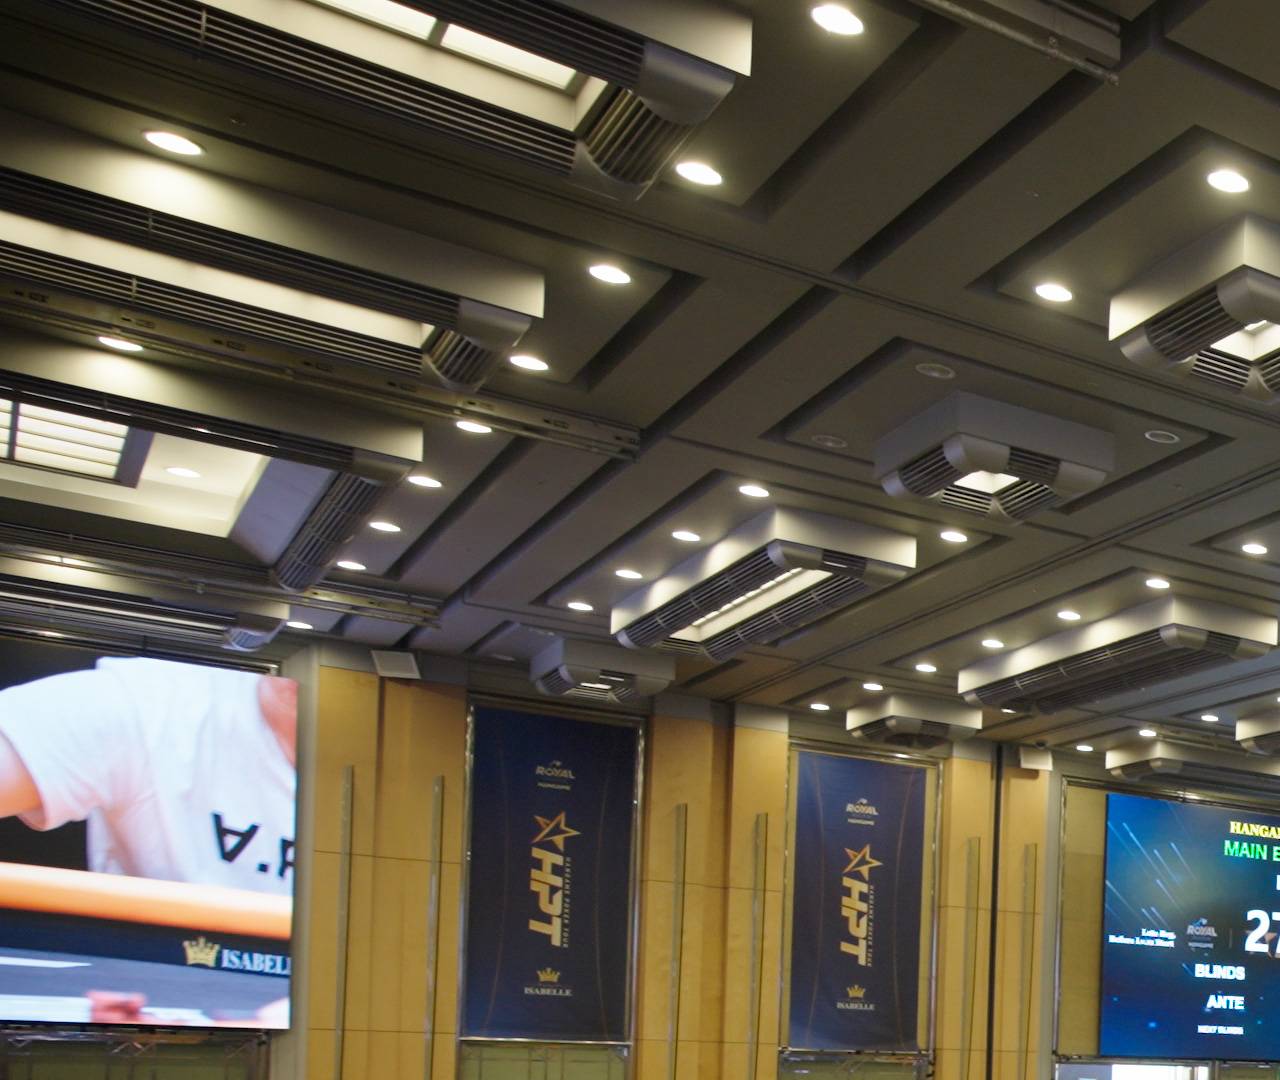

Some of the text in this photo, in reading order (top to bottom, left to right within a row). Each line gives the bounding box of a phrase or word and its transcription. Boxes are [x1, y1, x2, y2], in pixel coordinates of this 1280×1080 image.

[535, 765, 576, 780] ROYAL
[845, 803, 879, 816] ROYAL
[1224, 840, 1267, 860] MAIN
[528, 846, 565, 948] HPT
[840, 876, 869, 967] HPT
[1186, 925, 1217, 937] ROYAL
[1194, 963, 1246, 981] BLINDS
[523, 986, 573, 998] ISABELLE
[836, 1001, 876, 1011] ISABELLE
[1206, 995, 1245, 1010] ANTE
